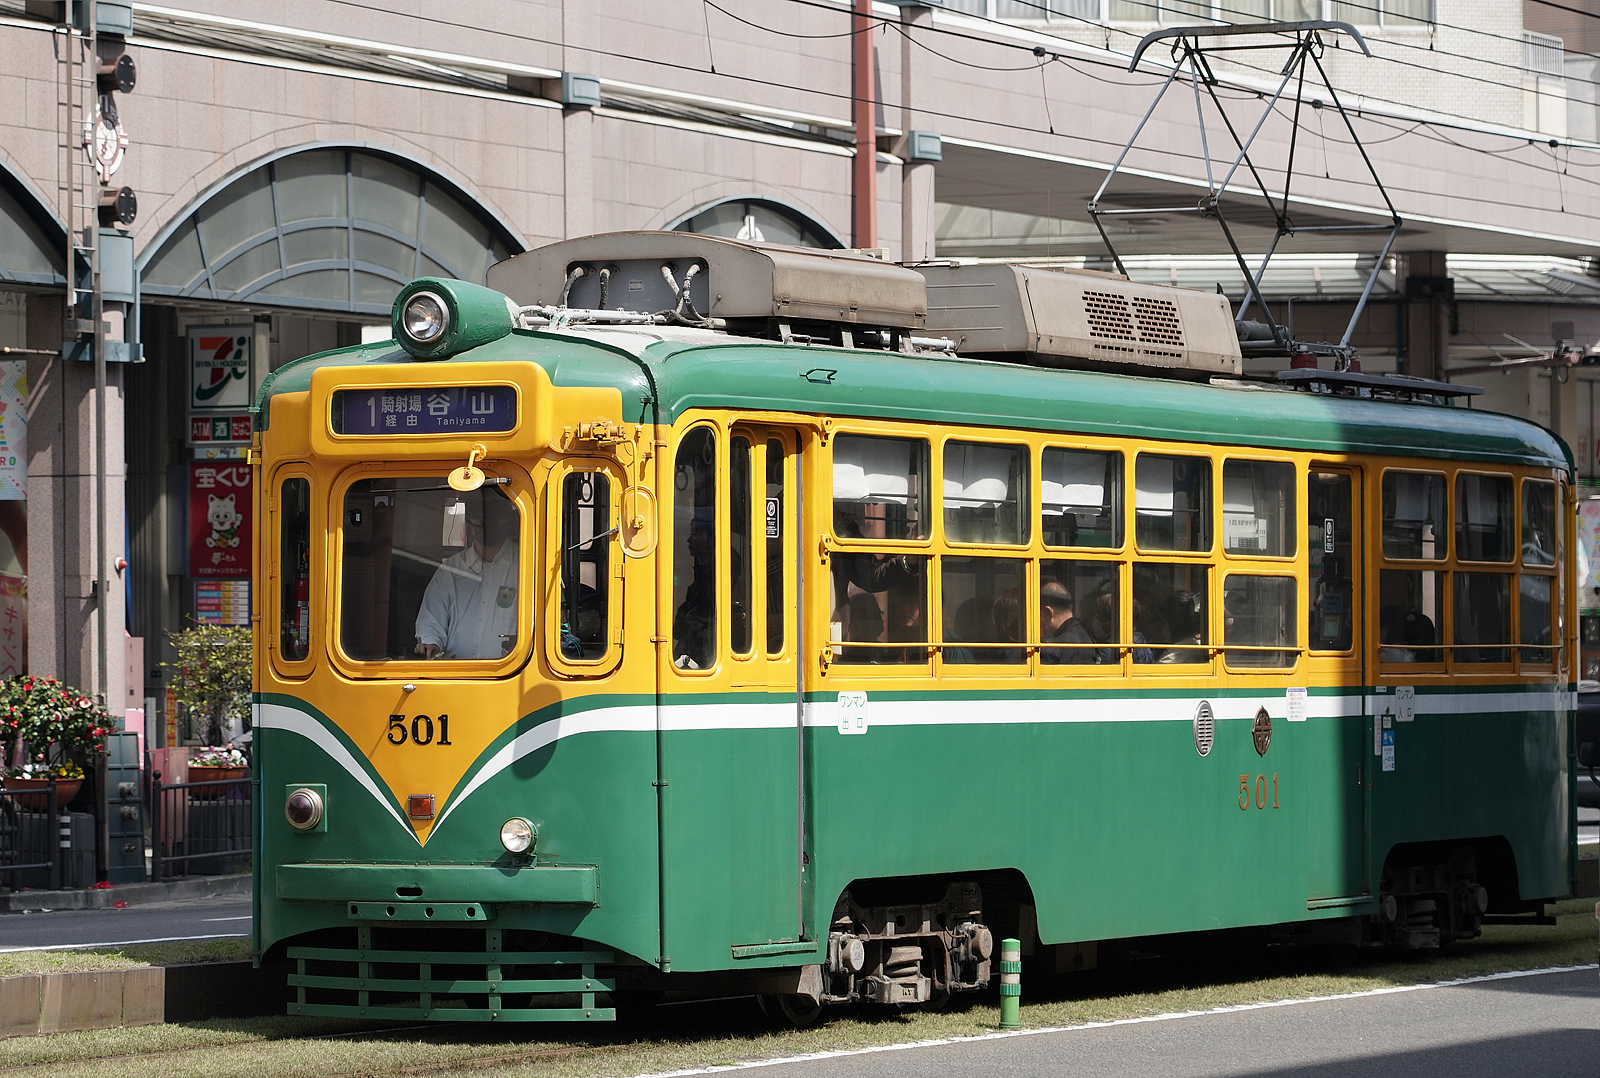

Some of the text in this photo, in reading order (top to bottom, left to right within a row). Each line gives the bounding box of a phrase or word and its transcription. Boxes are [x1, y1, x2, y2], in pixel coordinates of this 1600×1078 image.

[381, 395, 422, 412] 騎射場
[366, 396, 376, 427] 1
[214, 421, 228, 437] 酒
[436, 416, 486, 427] Taniyama
[192, 422, 211, 437] ATM
[195, 466, 250, 488] 宝くじ
[839, 695, 866, 708] ワンマン
[1396, 689, 1414, 700] ワンマン
[1398, 706, 1412, 719] 入口
[387, 714, 452, 746] 501
[842, 715, 863, 730] 出口
[1238, 772, 1280, 811] 501
